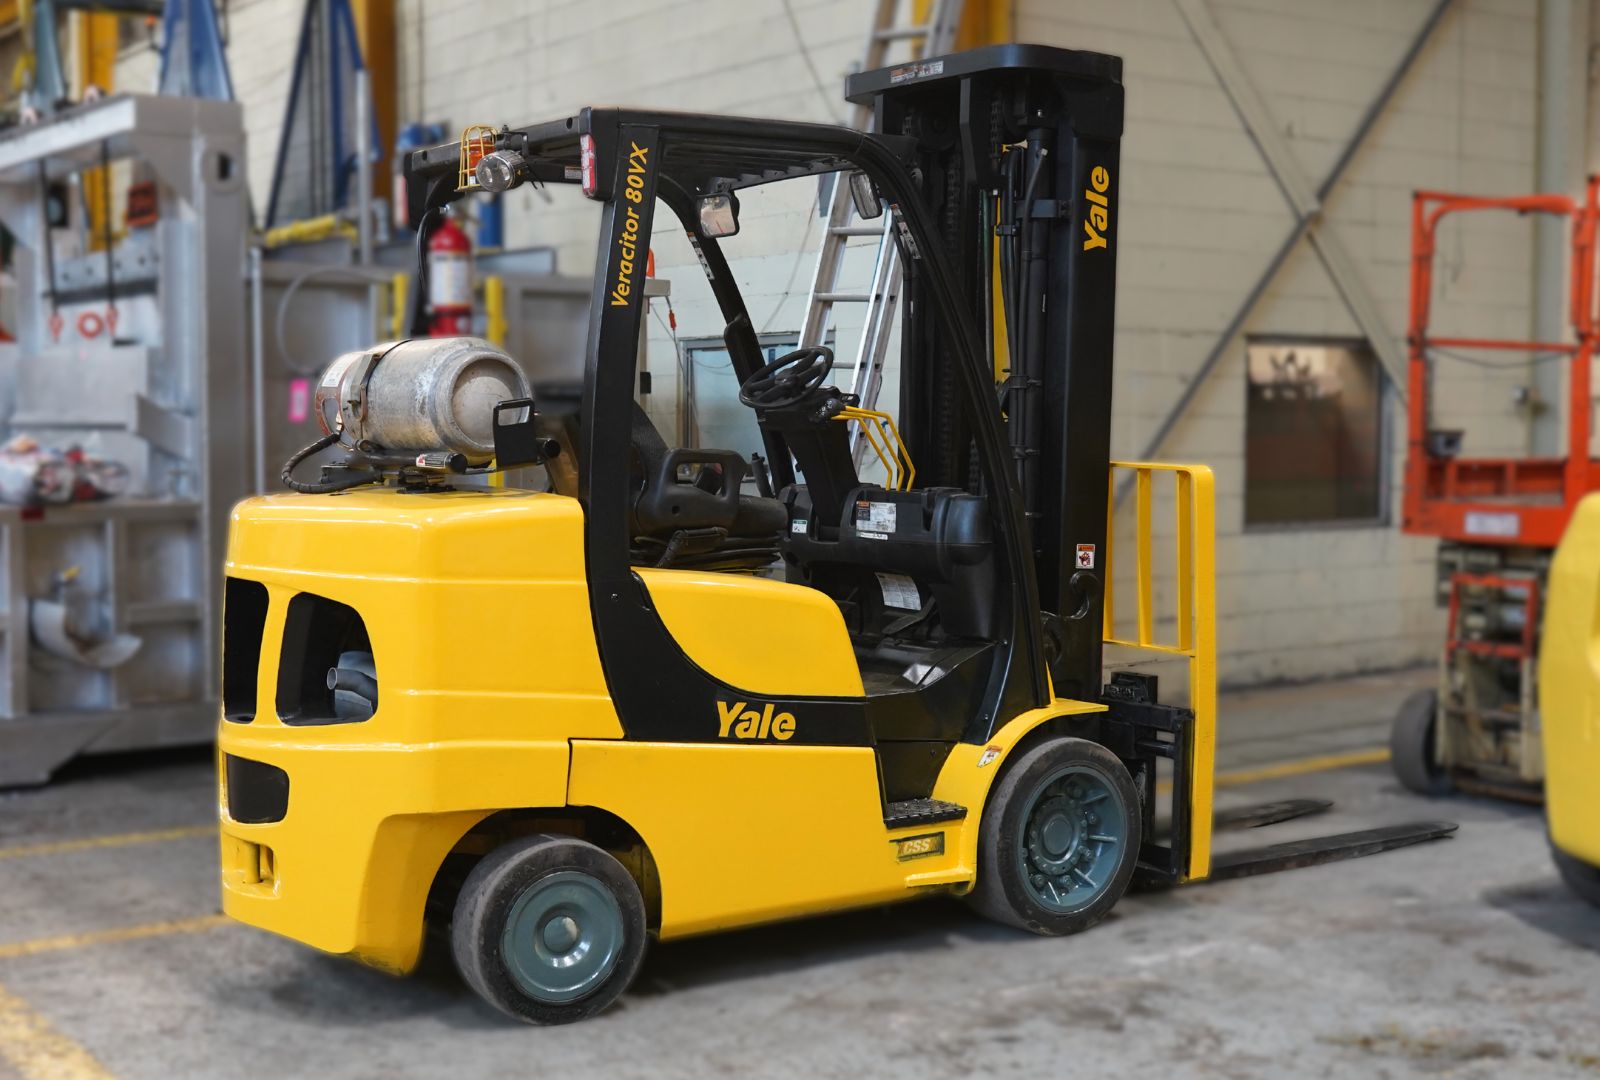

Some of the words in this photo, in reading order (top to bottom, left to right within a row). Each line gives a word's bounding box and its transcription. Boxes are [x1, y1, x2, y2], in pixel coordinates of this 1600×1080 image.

[625, 140, 649, 204] 80VX
[1083, 165, 1110, 251] Yale
[611, 206, 640, 307] Veracitor
[716, 701, 797, 741] Yale
[903, 839, 931, 853] CSS
